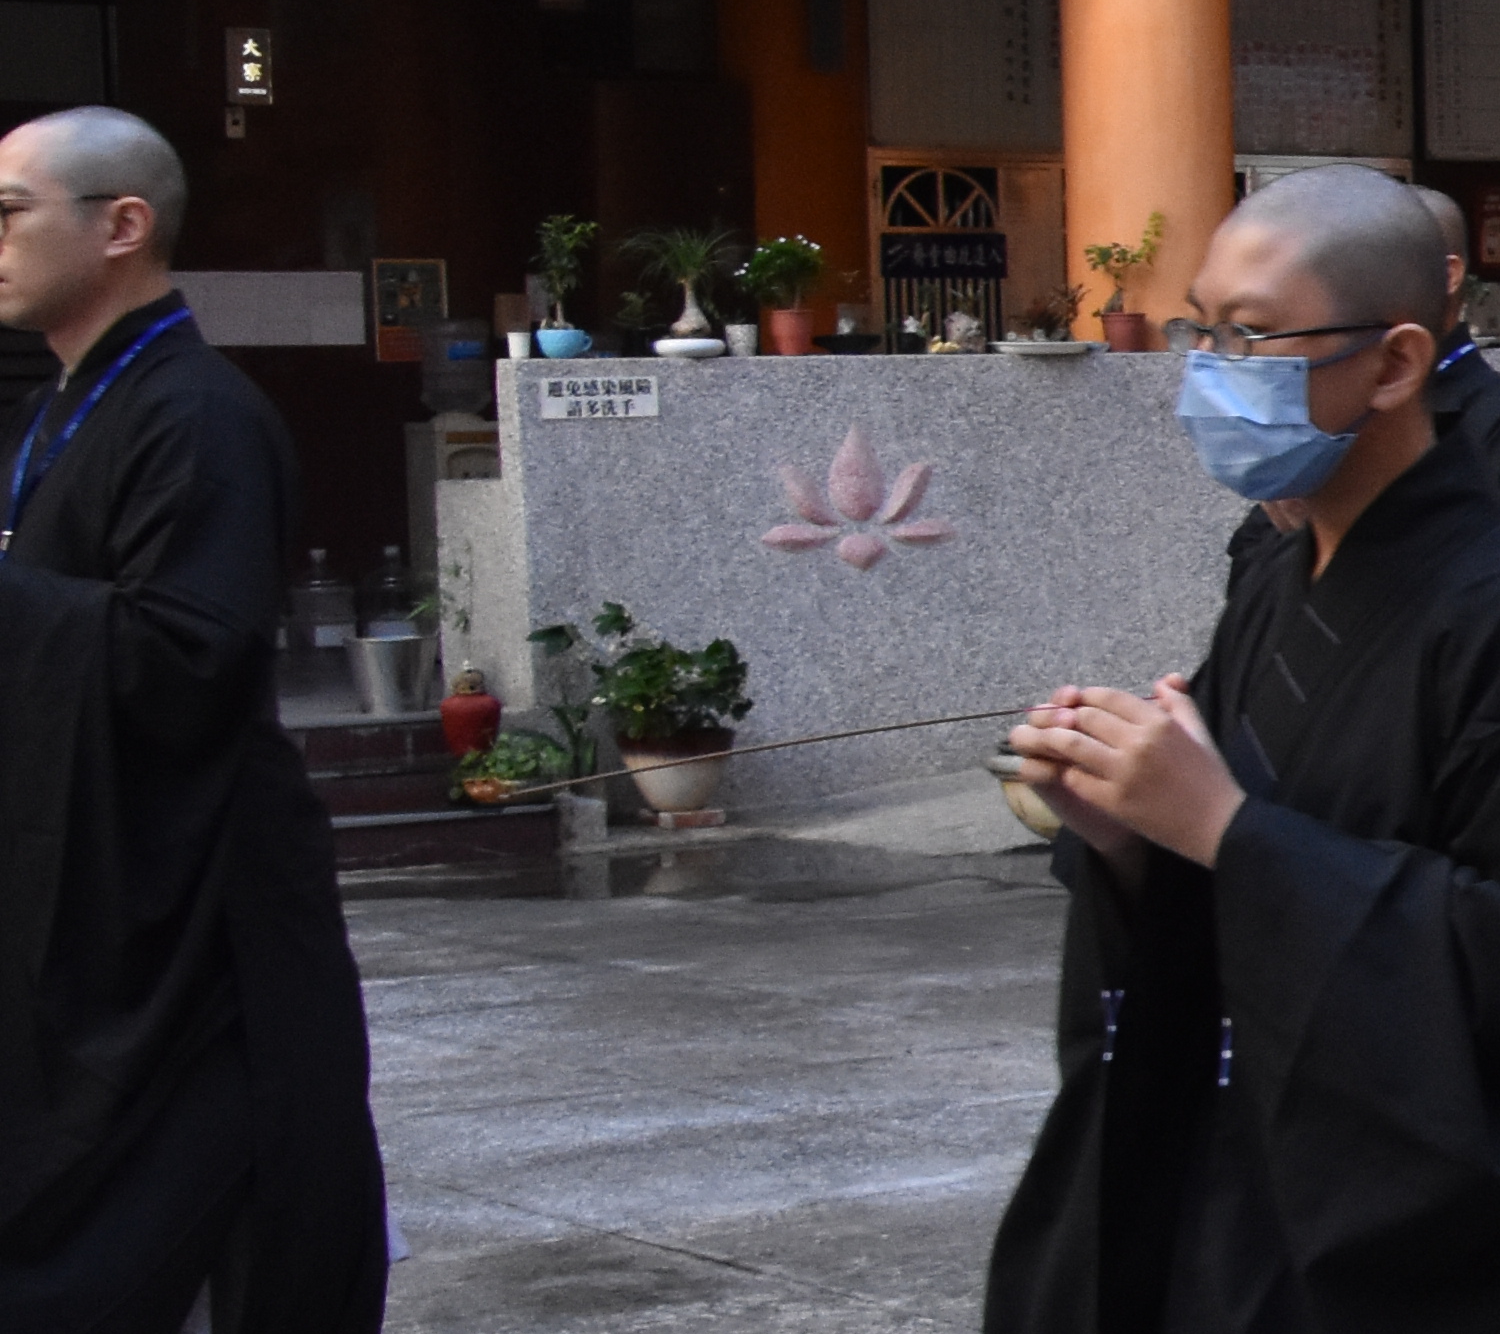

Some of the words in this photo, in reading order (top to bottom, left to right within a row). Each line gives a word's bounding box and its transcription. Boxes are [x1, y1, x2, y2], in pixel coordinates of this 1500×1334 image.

[547, 378, 652, 398] 避免感染風險
[566, 398, 636, 417] 請多洗手
